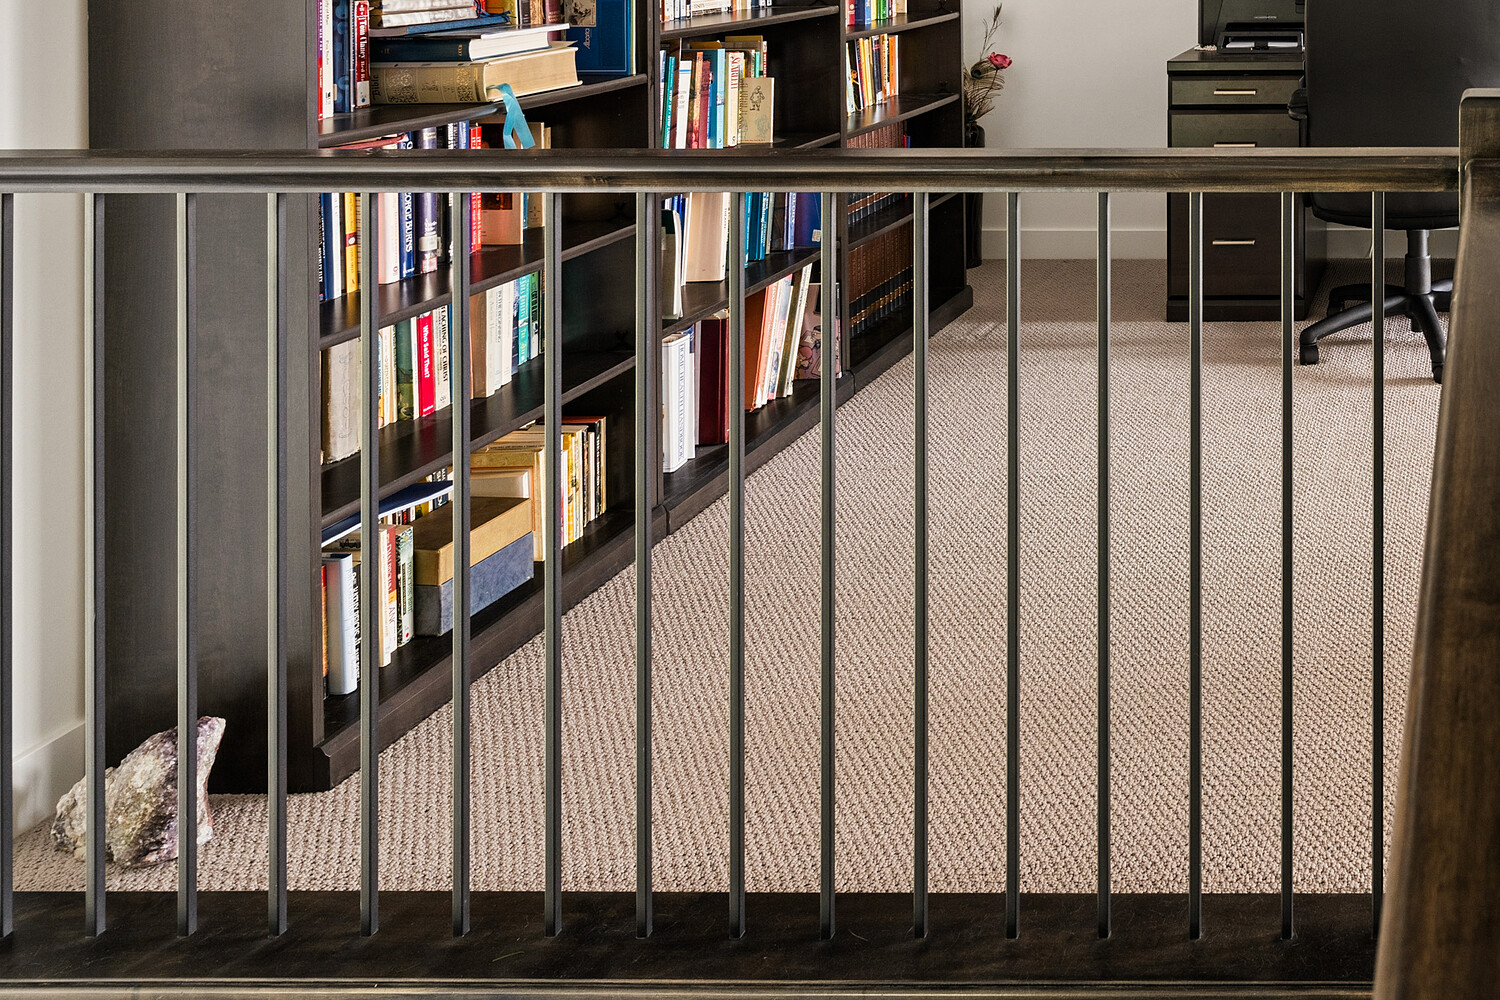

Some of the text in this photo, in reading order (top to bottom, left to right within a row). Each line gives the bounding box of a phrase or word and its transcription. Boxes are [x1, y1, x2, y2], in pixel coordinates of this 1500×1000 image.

[359, 20, 367, 36] Tom
[358, 37, 367, 60] Clancy
[730, 56, 741, 89] SCARLETT
[405, 193, 413, 252] ORGE BURNS
[442, 345, 448, 353] OF
